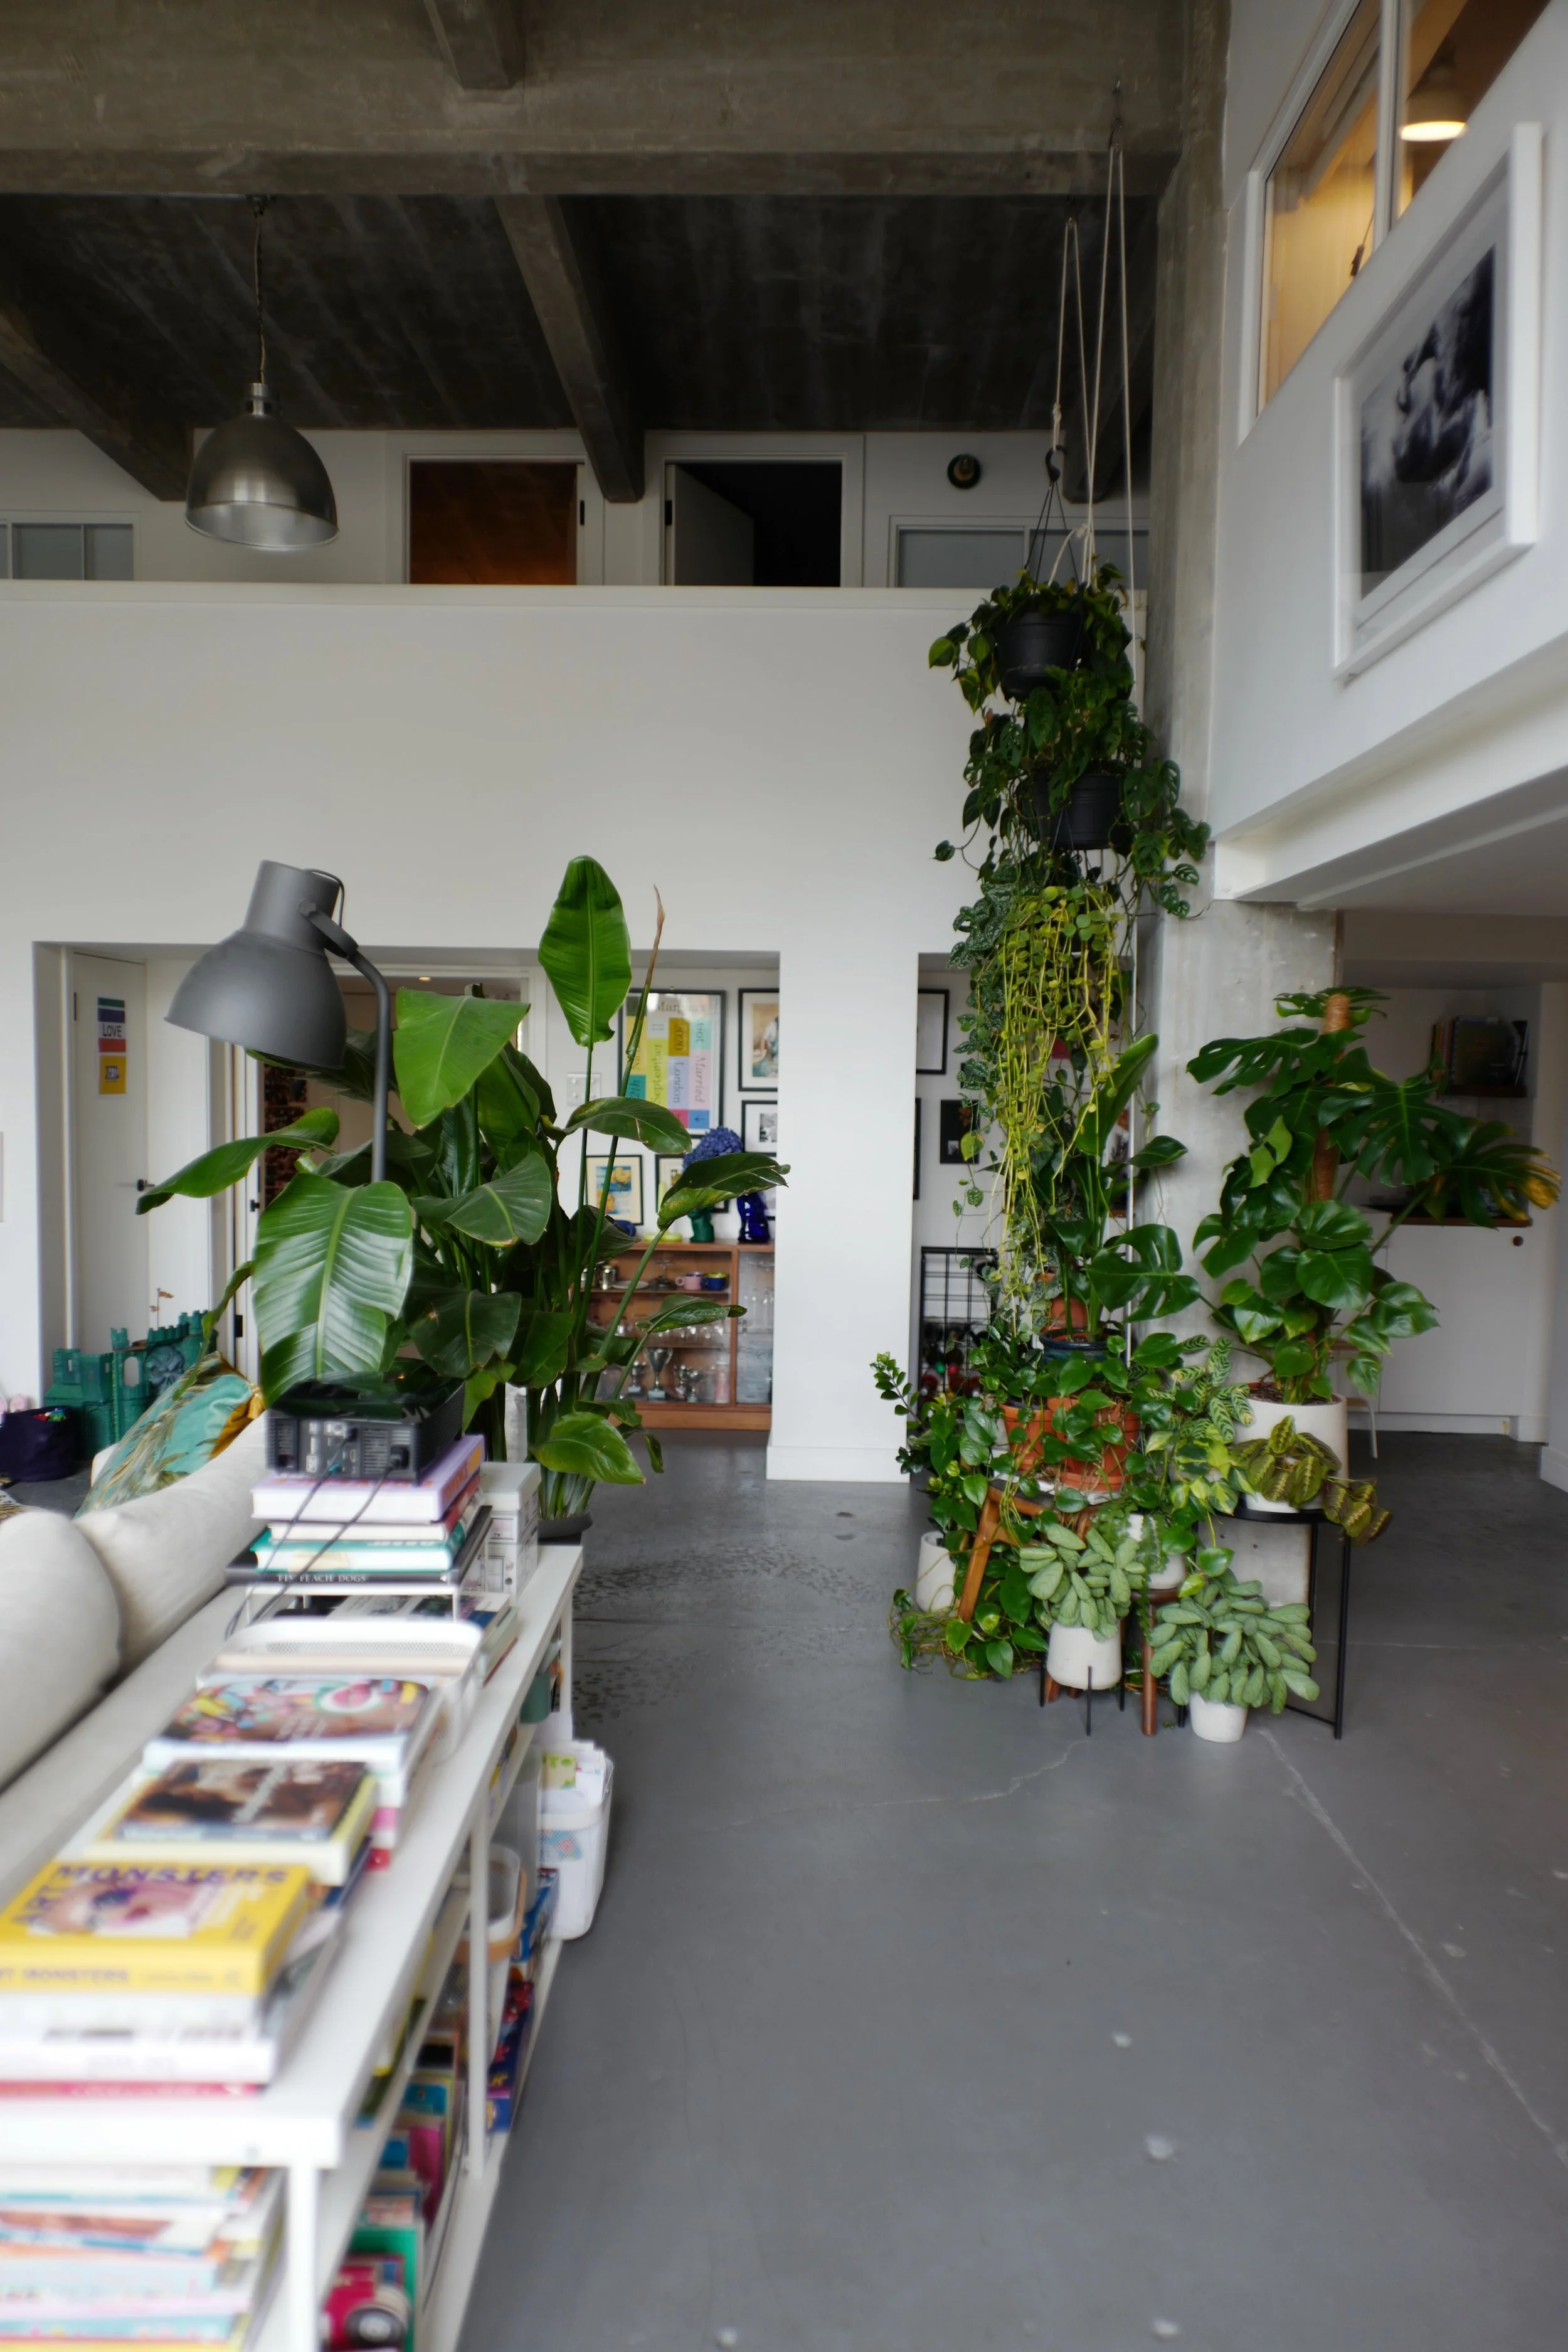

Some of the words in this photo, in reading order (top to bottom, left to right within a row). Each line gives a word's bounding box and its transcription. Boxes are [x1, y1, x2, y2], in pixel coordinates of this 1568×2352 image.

[102, 1024, 122, 1038] LOVE
[674, 1023, 684, 1051] 2020
[696, 1023, 705, 1044] Got
[652, 1044, 664, 1104] September
[673, 1062, 685, 1103] London
[694, 1056, 706, 1103] Married
[338, 1574, 366, 1582] DOGS
